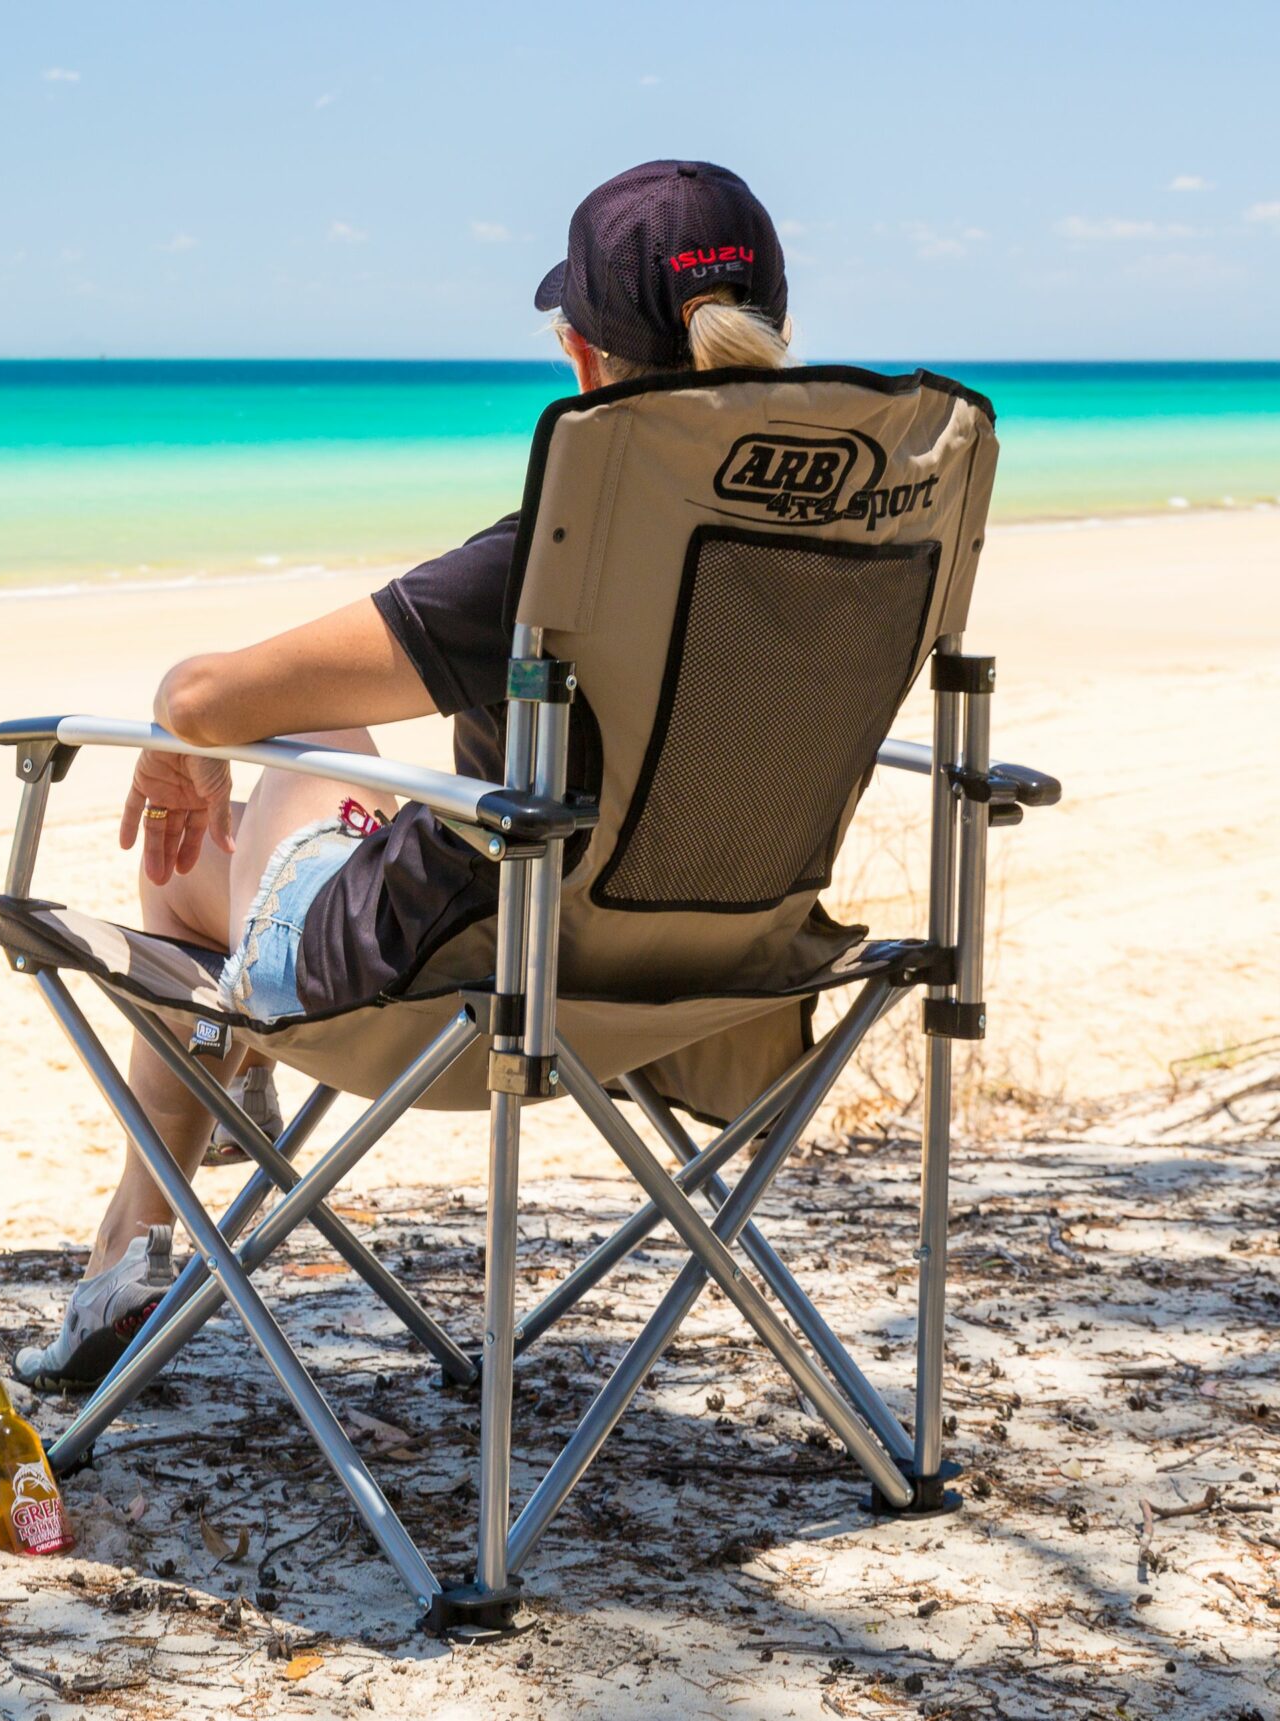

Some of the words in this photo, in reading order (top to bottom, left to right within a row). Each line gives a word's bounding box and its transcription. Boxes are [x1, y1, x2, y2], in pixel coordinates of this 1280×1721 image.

[670, 246, 753, 272] ISUZU
[691, 261, 744, 278] UTE
[730, 445, 841, 493] ARB
[843, 473, 939, 532] sport
[13, 1498, 61, 1528] GREA
